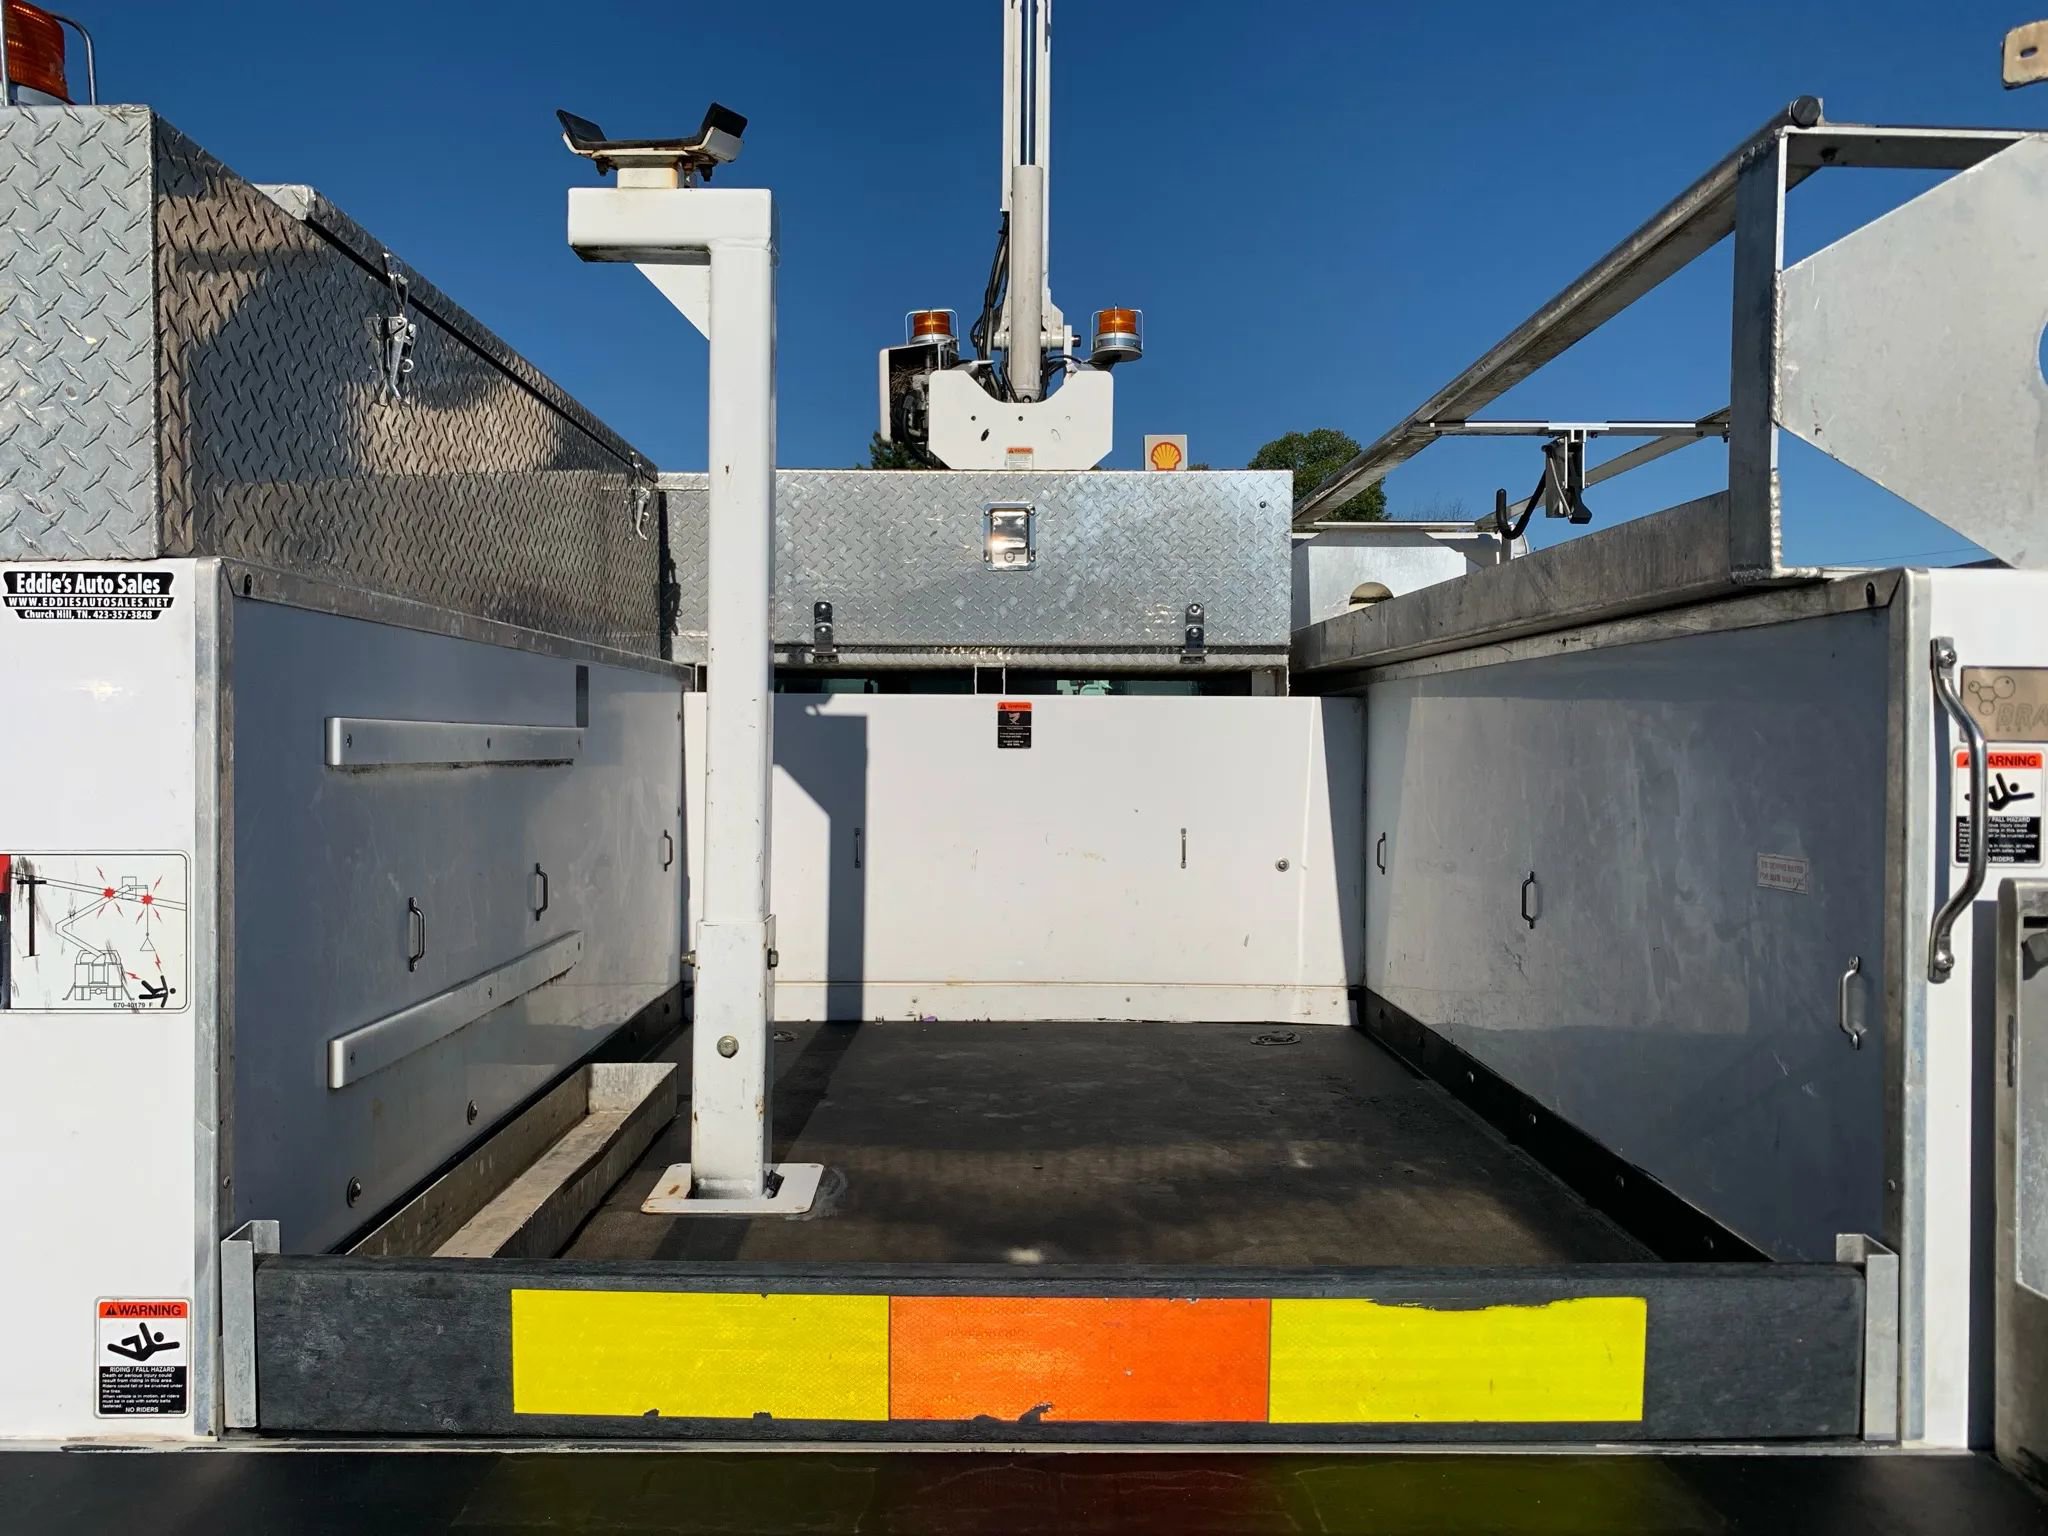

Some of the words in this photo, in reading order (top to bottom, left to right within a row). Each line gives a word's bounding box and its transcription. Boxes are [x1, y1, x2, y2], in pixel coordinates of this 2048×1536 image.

[16, 573, 72, 594] Eddie's
[75, 573, 114, 594] Auto
[117, 573, 160, 594] Sales
[9, 597, 169, 607] WWW.EDDIESAUTOSALES.NET
[24, 610, 54, 619] Church
[56, 610, 74, 620] Hill,
[77, 610, 91, 619] TN.
[93, 610, 153, 619] 423-357-3848
[1988, 755, 2037, 767] ARNING
[118, 1305, 182, 1316] WARNING
